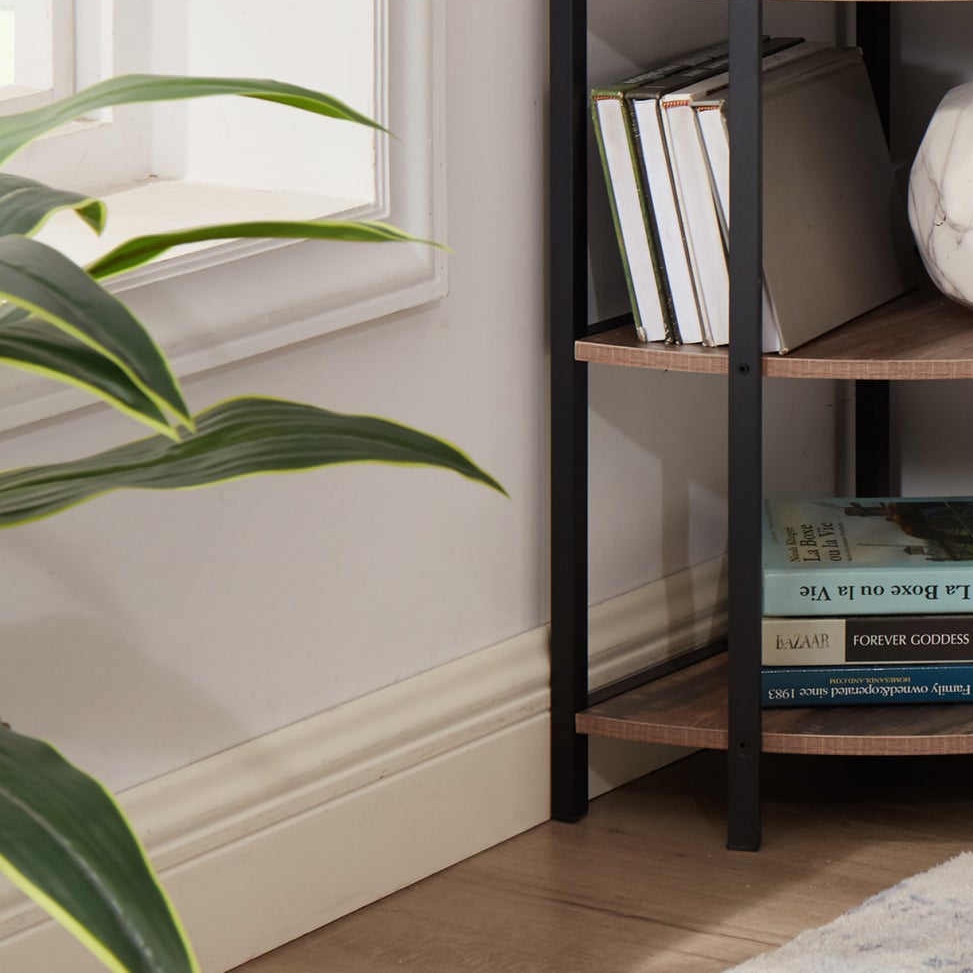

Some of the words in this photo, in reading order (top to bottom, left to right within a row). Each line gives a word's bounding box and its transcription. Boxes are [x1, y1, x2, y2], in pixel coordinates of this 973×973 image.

[786, 526, 798, 546] Klieger
[800, 524, 817, 547] Boxe
[819, 522, 833, 538] Vie
[823, 539, 839, 549] la
[790, 546, 801, 562] Noah
[803, 549, 821, 562] La
[829, 549, 842, 562] ou
[799, 586, 833, 602] Vie
[837, 586, 855, 602] la
[860, 585, 886, 597] ou
[891, 585, 938, 601] Boxe
[945, 585, 971, 600] La
[775, 633, 830, 650] BAZAAR
[853, 634, 907, 646] FOREVER
[910, 633, 970, 645] GODDESS
[768, 688, 796, 700] 1983
[799, 687, 828, 698] since
[831, 683, 929, 698] owned&operated
[930, 682, 971, 696] Family
